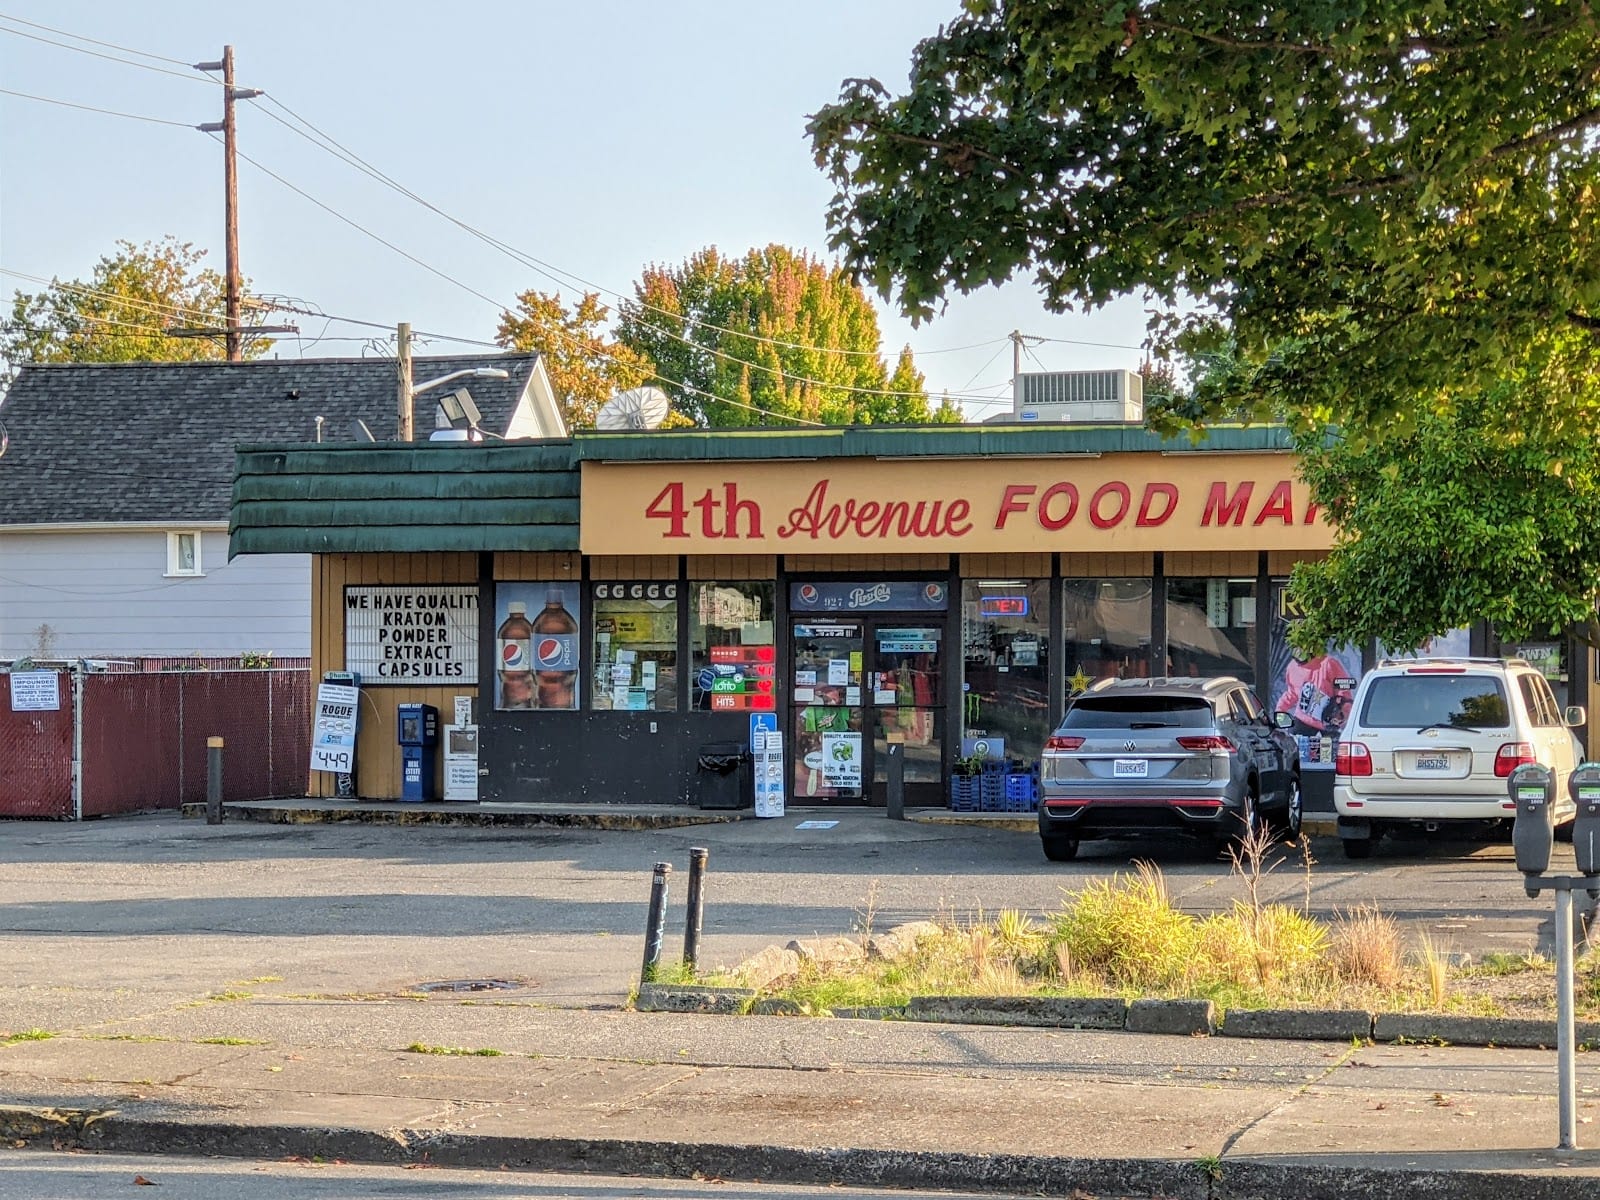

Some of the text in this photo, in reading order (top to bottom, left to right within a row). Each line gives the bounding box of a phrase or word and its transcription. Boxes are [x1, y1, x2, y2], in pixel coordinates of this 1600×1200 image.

[645, 482, 764, 539] 4th
[777, 478, 973, 539] Avenue
[994, 480, 1179, 531] FOOD
[347, 595, 368, 608] WE
[374, 595, 413, 608] HAVE
[383, 611, 446, 626] KRATOM
[379, 628, 447, 643] POWDER
[384, 645, 452, 660] EXTRACT
[562, 639, 571, 666] pepsi
[378, 662, 463, 677] CAPSULES
[321, 704, 353, 716] ROGUE
